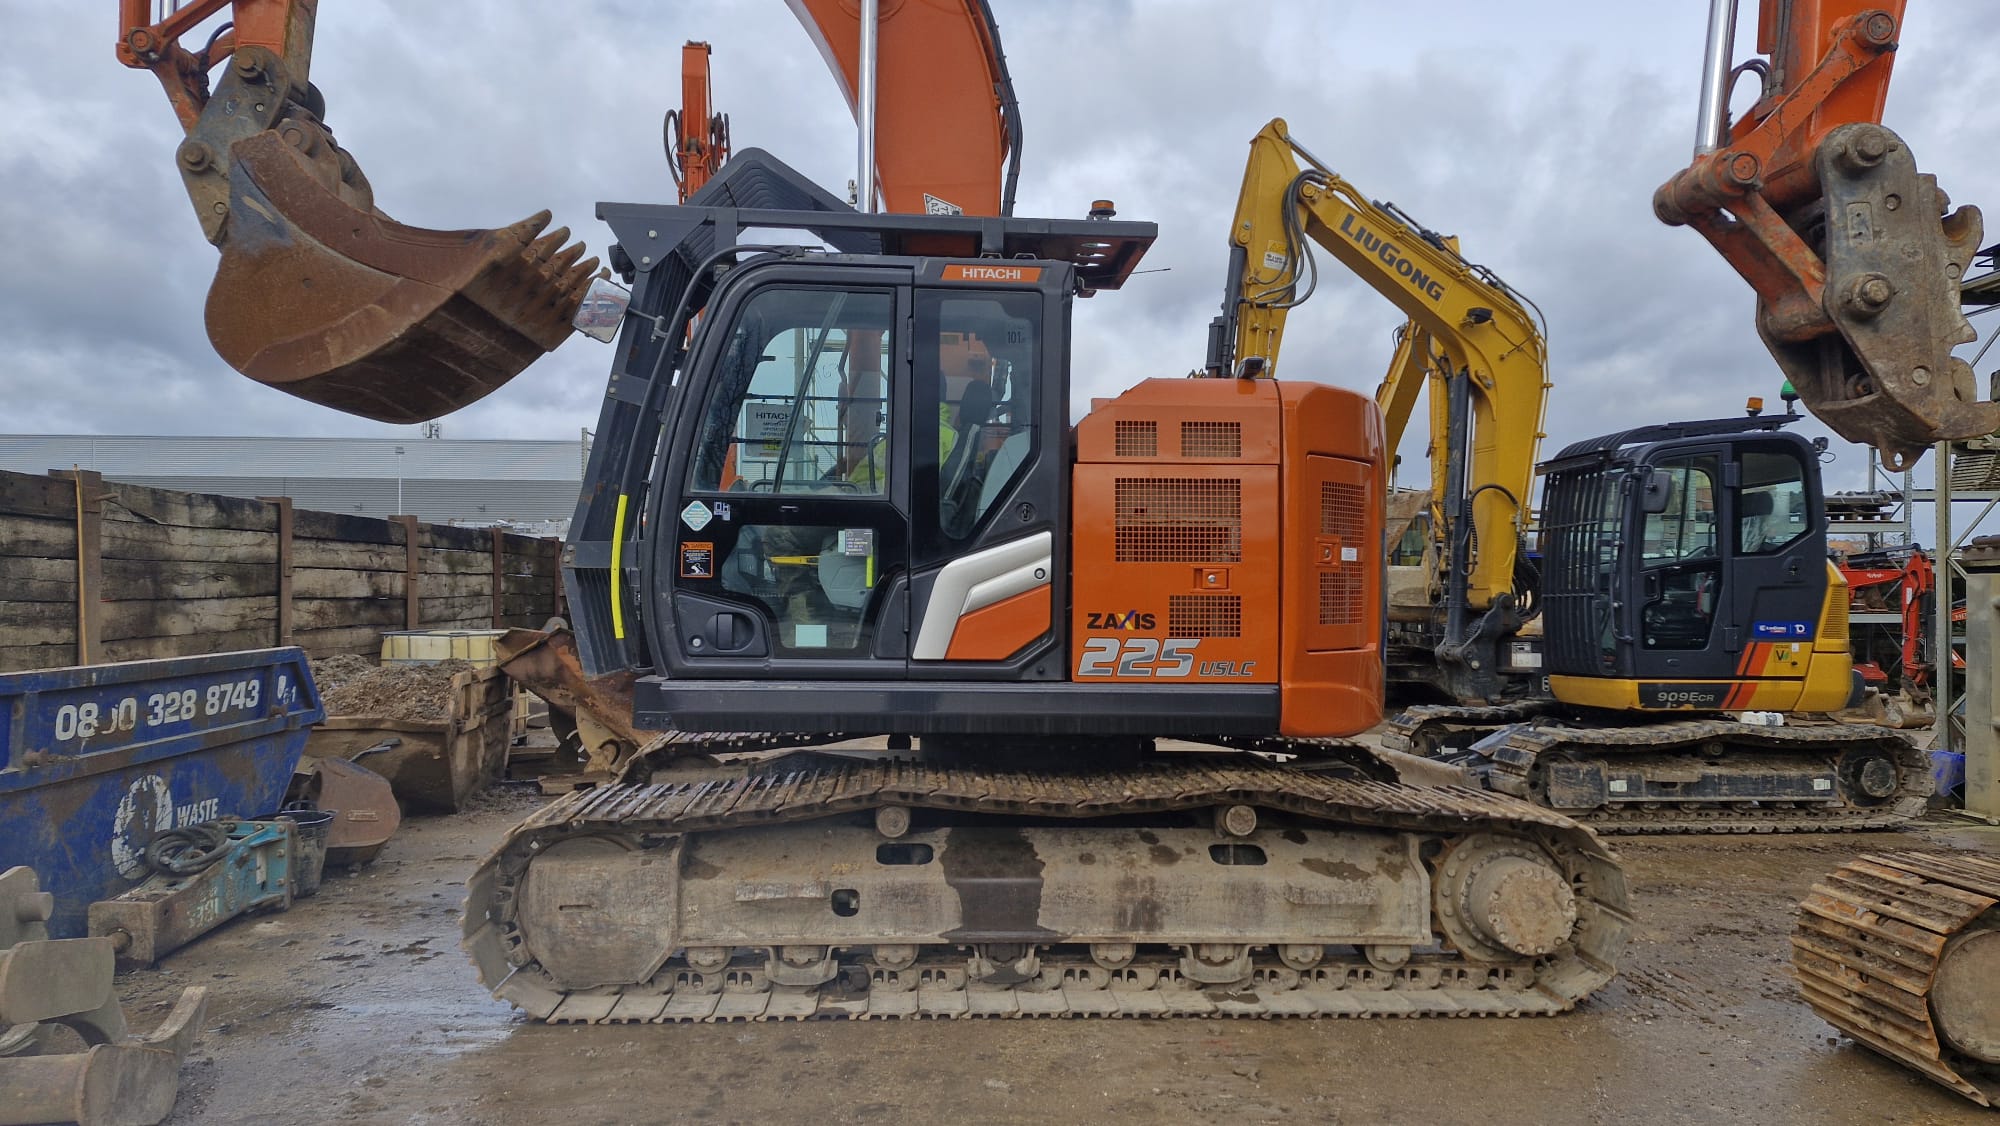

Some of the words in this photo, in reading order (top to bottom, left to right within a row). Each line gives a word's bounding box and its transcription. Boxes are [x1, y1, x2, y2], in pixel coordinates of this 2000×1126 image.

[962, 267, 1021, 280] HITACHI
[755, 412, 791, 420] HITACH
[1086, 609, 1156, 631] ZAXIS
[1077, 637, 1202, 677] 225
[1199, 660, 1256, 677] USLC
[147, 688, 198, 727] 328
[204, 678, 260, 717] 8743
[177, 798, 219, 829] WASTE
